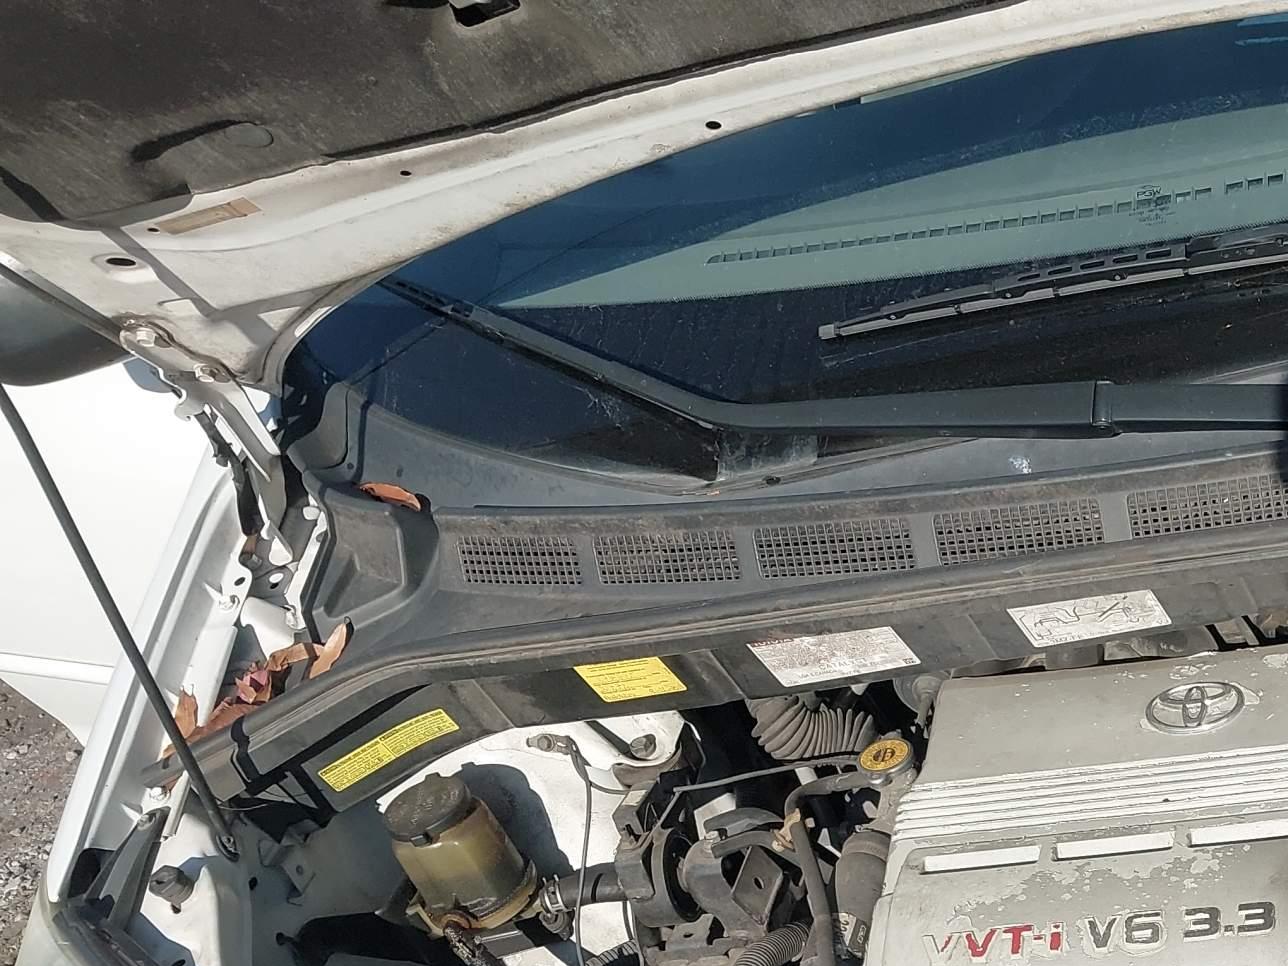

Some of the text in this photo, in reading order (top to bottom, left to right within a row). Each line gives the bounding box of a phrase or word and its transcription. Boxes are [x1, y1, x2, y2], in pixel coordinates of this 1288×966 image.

[1136, 186, 1162, 199] PGW
[1083, 910, 1167, 957] V6
[1181, 901, 1278, 943] 3.3
